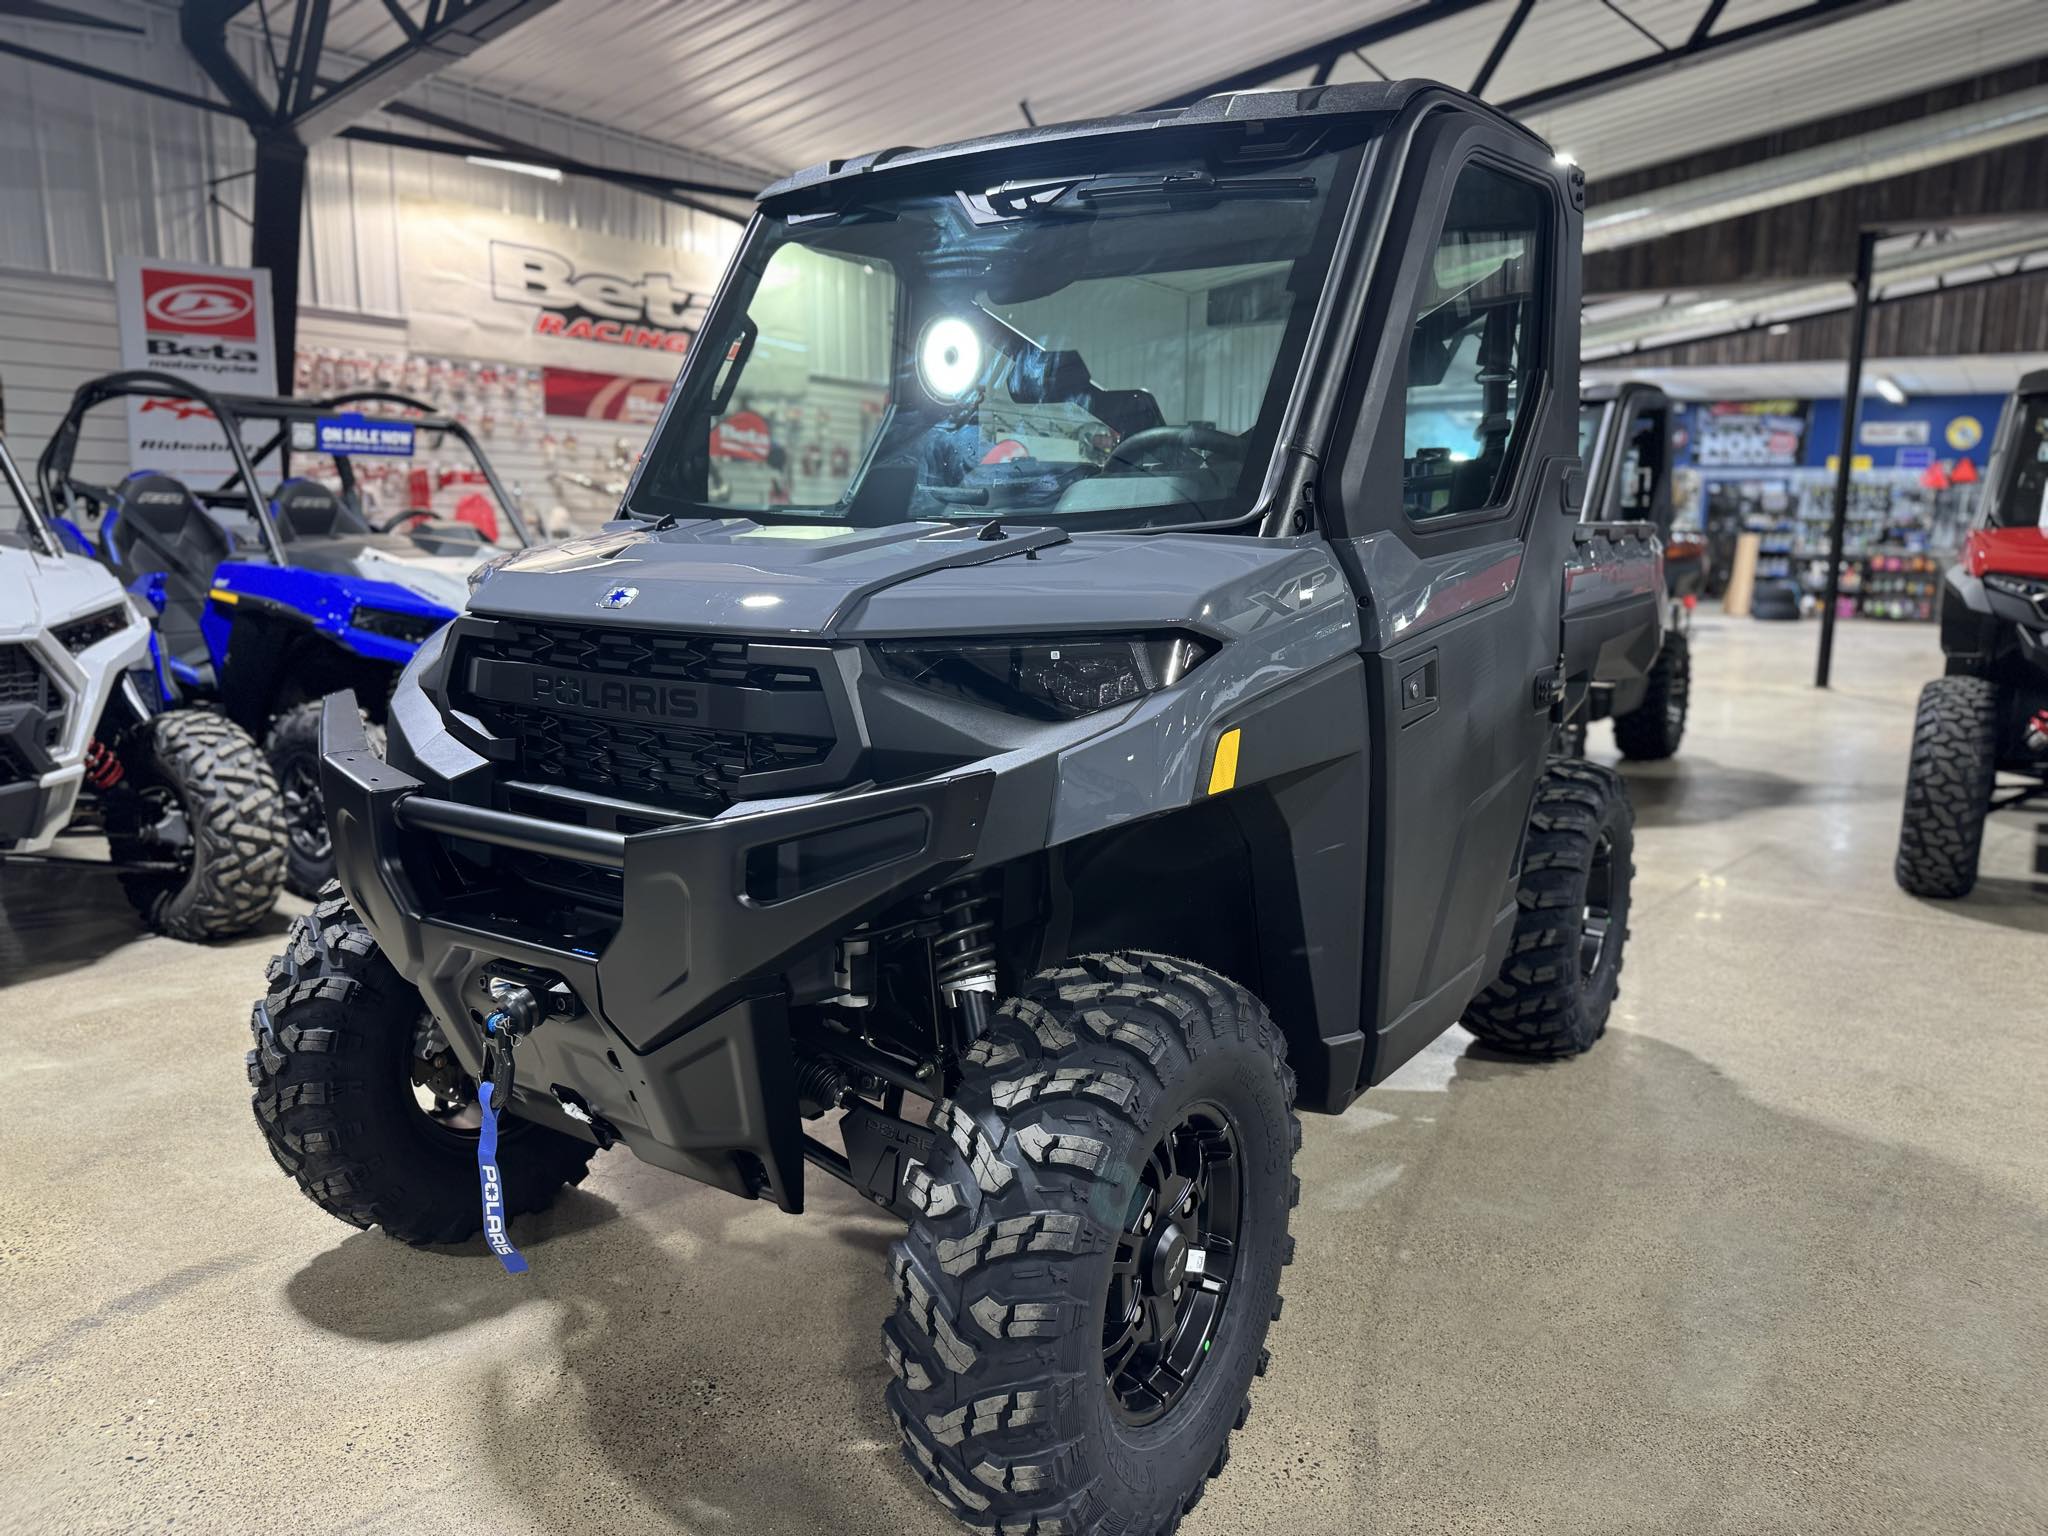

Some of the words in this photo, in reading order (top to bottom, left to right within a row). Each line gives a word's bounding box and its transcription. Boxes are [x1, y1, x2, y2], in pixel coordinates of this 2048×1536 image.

[147, 339, 258, 362] Beta
[536, 313, 690, 353] RACING
[149, 359, 258, 374] motorcycles
[321, 427, 342, 443] ON
[344, 427, 379, 445] SALE
[381, 430, 412, 446] NOW
[1245, 564, 1339, 632] XP
[535, 672, 699, 719] POLARIS
[482, 1164, 514, 1256] POLARIS
